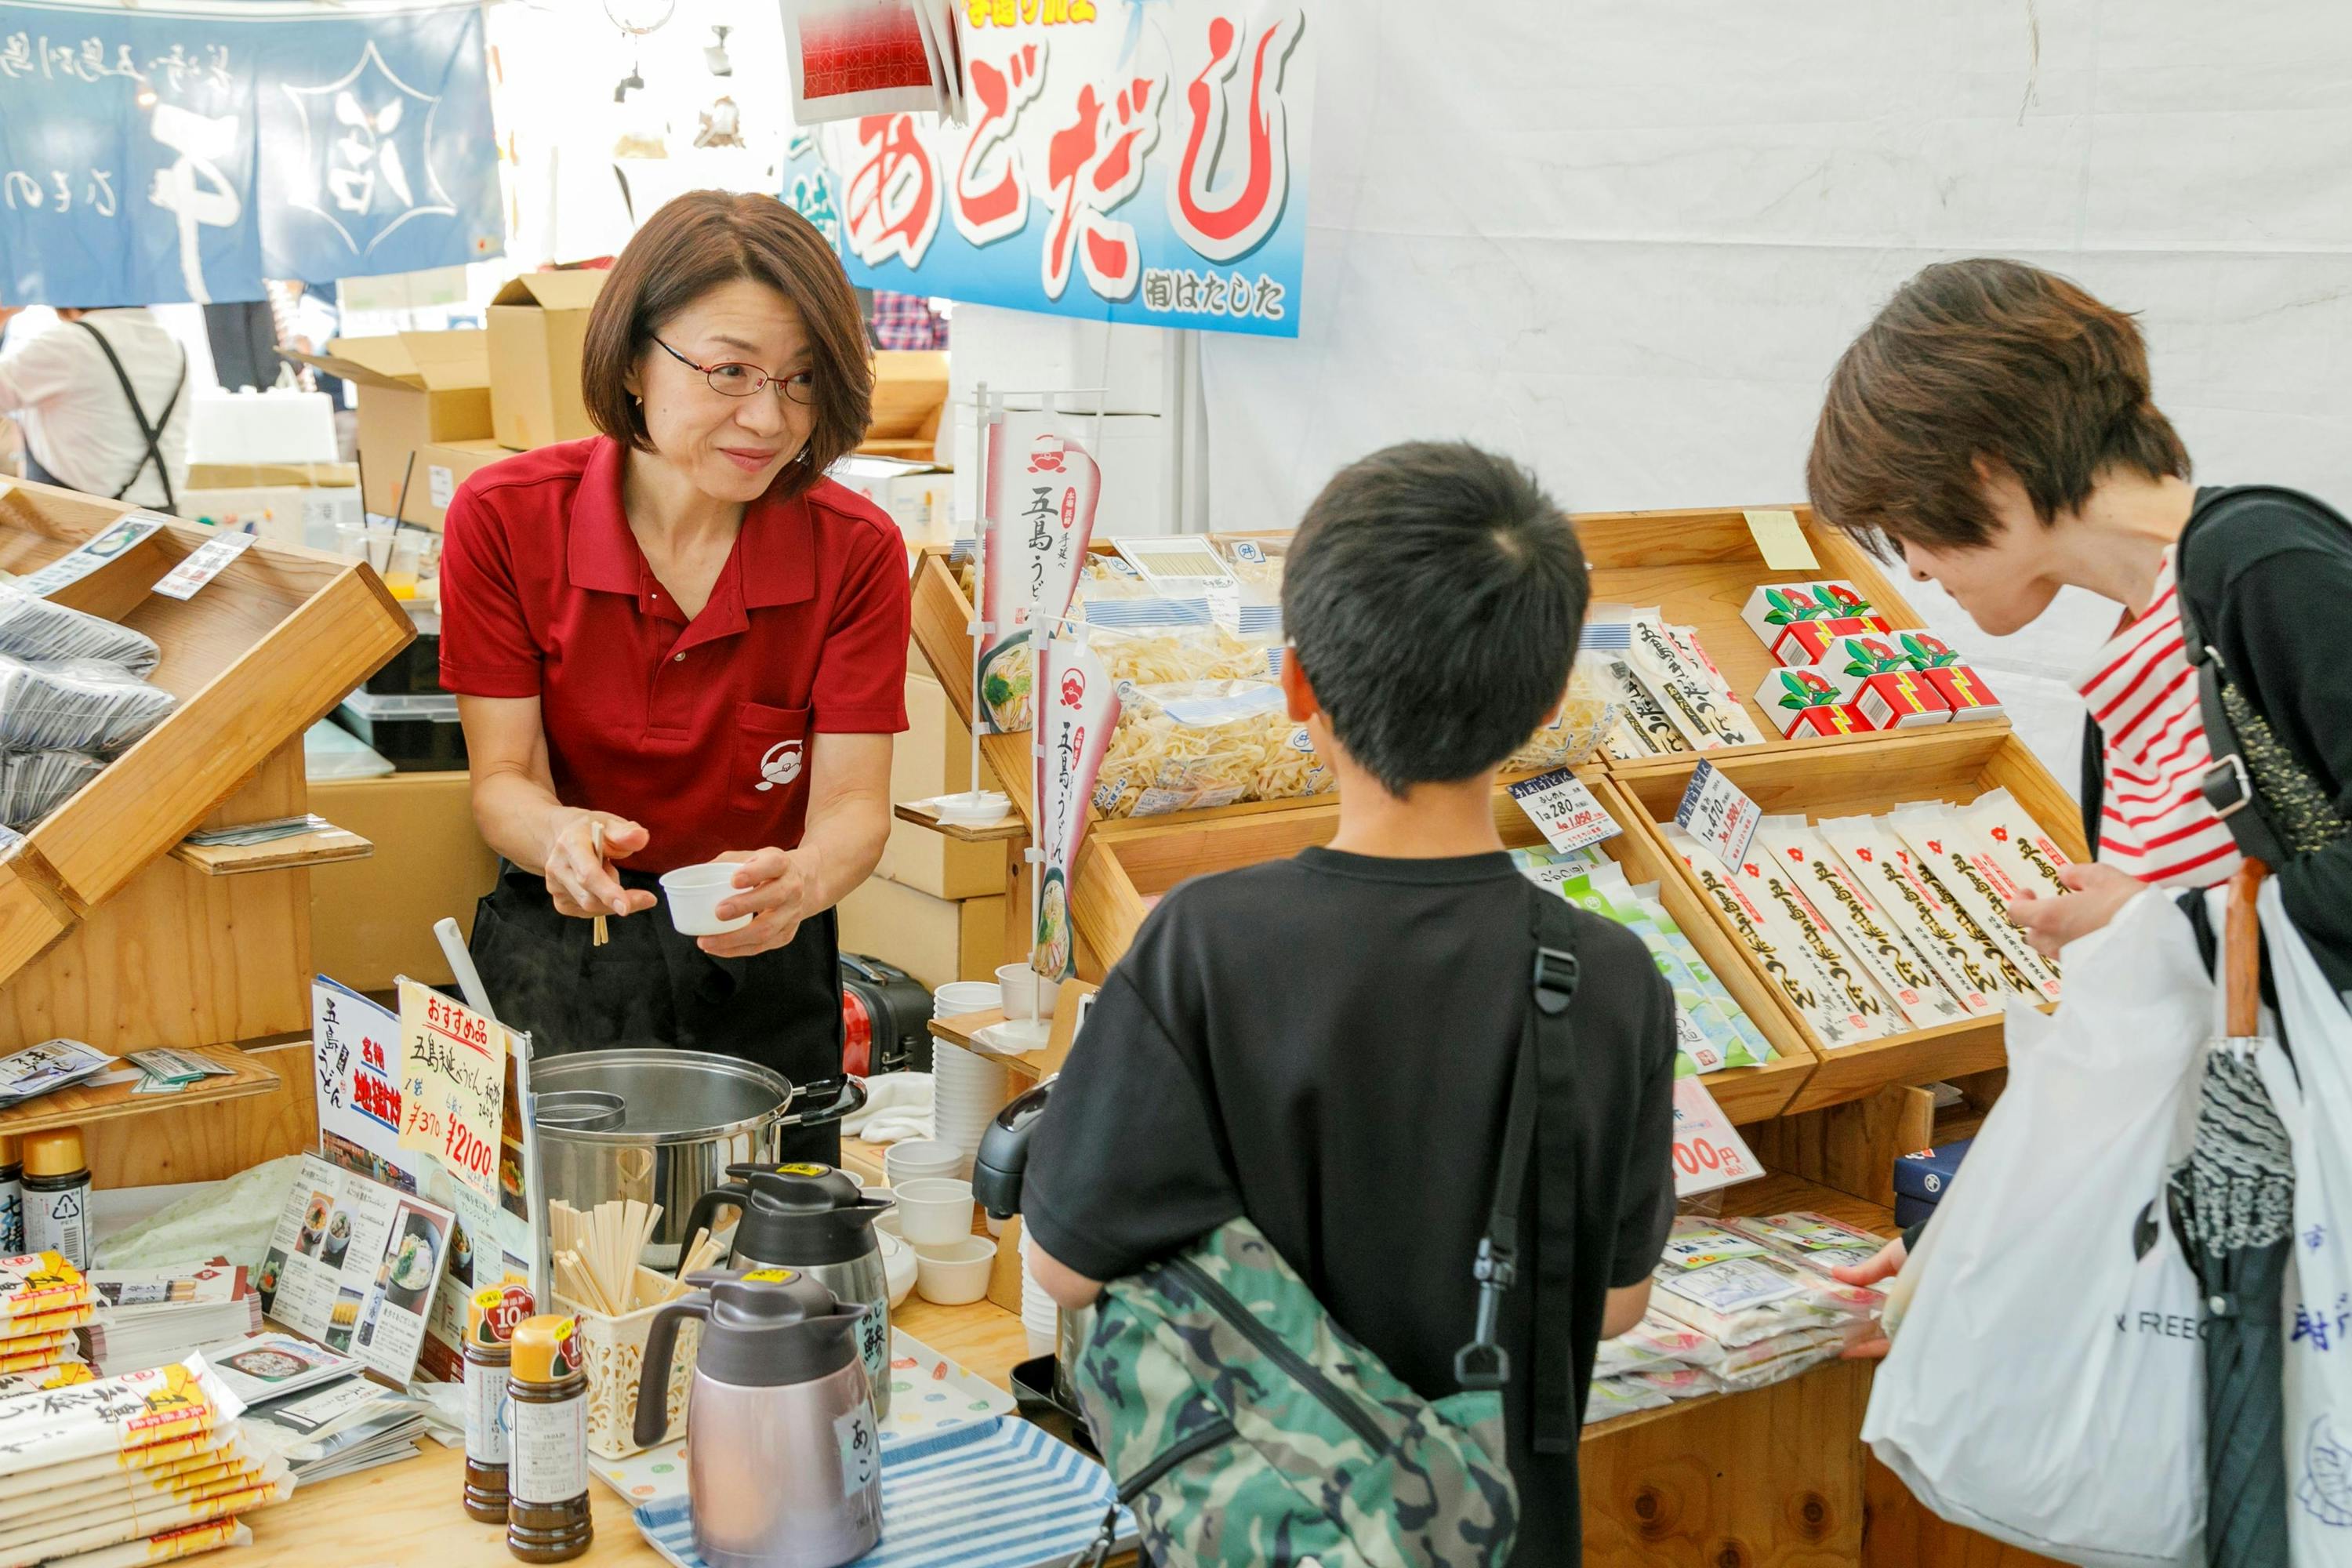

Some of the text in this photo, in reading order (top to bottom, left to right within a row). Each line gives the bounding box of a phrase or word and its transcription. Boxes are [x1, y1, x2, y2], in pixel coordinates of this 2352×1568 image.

[1022, 487, 1058, 622] 五島うど
[1549, 799, 1573, 818] 280
[1708, 800, 1724, 828] 470
[428, 995, 487, 1045] おすすめ品
[1672, 1137, 1740, 1178] 00円
